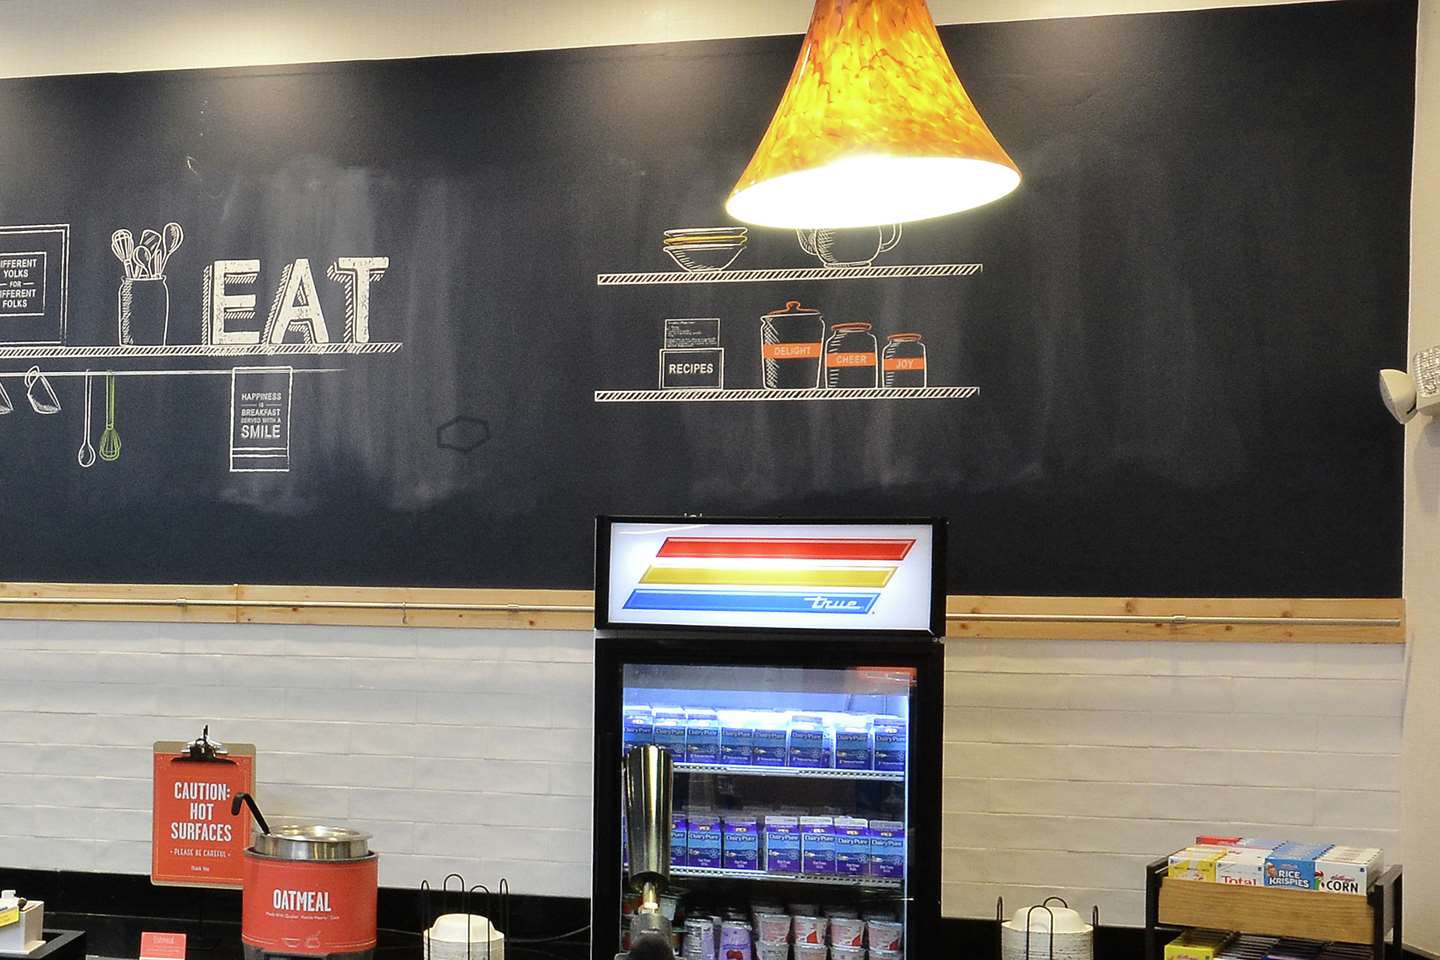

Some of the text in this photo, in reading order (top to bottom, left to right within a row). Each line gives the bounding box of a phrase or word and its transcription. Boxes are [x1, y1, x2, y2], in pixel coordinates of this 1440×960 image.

[3, 269, 29, 278] YOLKS
[2, 299, 28, 309] FOLKS
[211, 256, 390, 345] EAT
[773, 346, 811, 356] DELIGHT
[836, 355, 868, 364] CHEER
[896, 359, 916, 370] JOY
[669, 363, 714, 375] RECIPES
[241, 392, 282, 401] HAPPINESS
[241, 408, 281, 417] BREAKFAST
[241, 424, 281, 439] SMILE
[803, 595, 863, 609] true
[174, 782, 231, 801] CAUTION:
[190, 802, 214, 821] HOT
[171, 822, 232, 842] SURFACES
[174, 848, 193, 857] PLEASE
[204, 850, 227, 858] CAREFUL
[1278, 869, 1301, 879] RICE
[1220, 875, 1257, 886] Total
[1269, 877, 1310, 889] KRISPIES
[1326, 880, 1359, 893] CORN
[273, 889, 332, 912] OATMEAL
